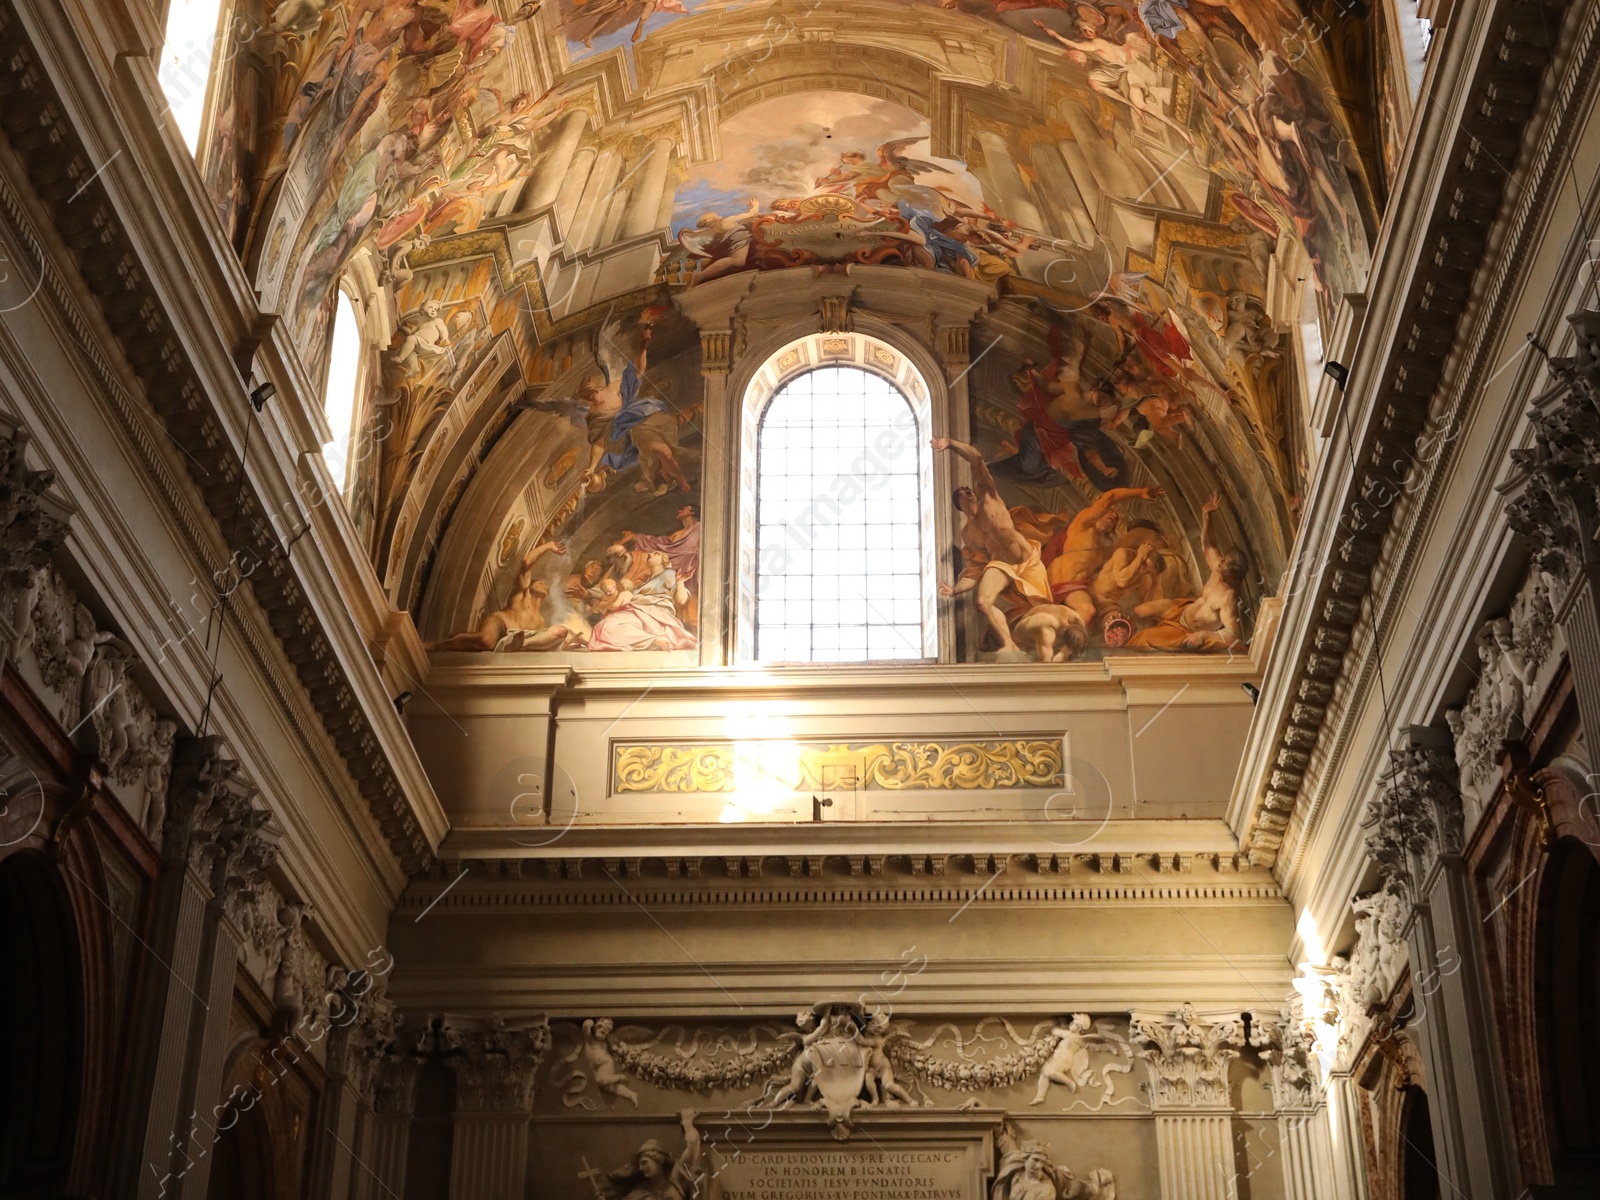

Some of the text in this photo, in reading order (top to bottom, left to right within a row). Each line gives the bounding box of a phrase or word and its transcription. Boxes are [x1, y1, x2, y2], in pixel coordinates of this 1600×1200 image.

[765, 1166, 778, 1176] IN
[783, 1166, 846, 1176] HONOREM
[749, 1177, 934, 1188] SOCIETATIS IESV FVNDATORIS
[721, 1190, 756, 1200] QVEM
